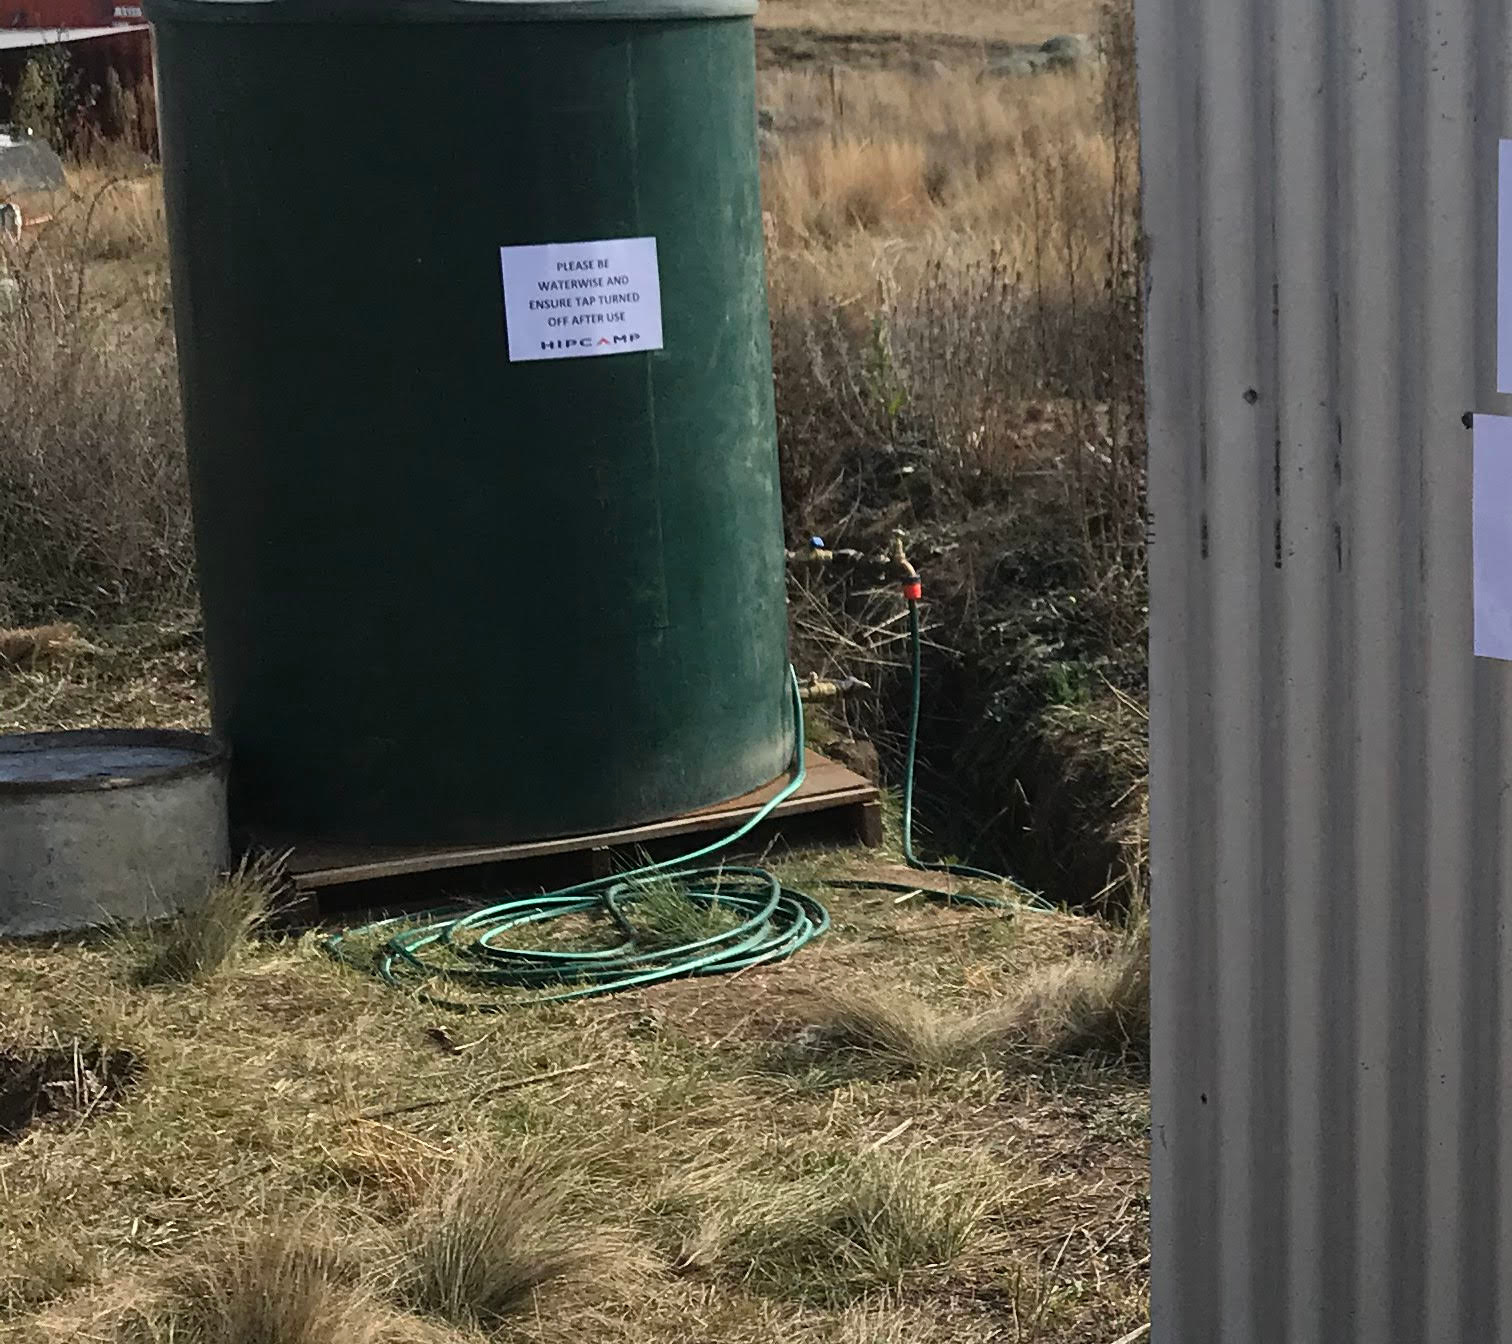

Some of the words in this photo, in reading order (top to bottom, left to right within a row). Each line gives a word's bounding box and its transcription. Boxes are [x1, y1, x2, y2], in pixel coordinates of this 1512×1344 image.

[557, 260, 593, 271] PLEASE
[598, 259, 608, 269] BE
[538, 277, 602, 291] WATERWISE
[607, 275, 629, 286] AND
[529, 298, 572, 310] ENSURE
[575, 296, 595, 306] TAP
[599, 293, 640, 304] TURNED
[548, 317, 568, 327] OFF
[572, 314, 603, 325] AFTER
[607, 312, 625, 322] USE
[541, 333, 640, 350] HIPCAMP
